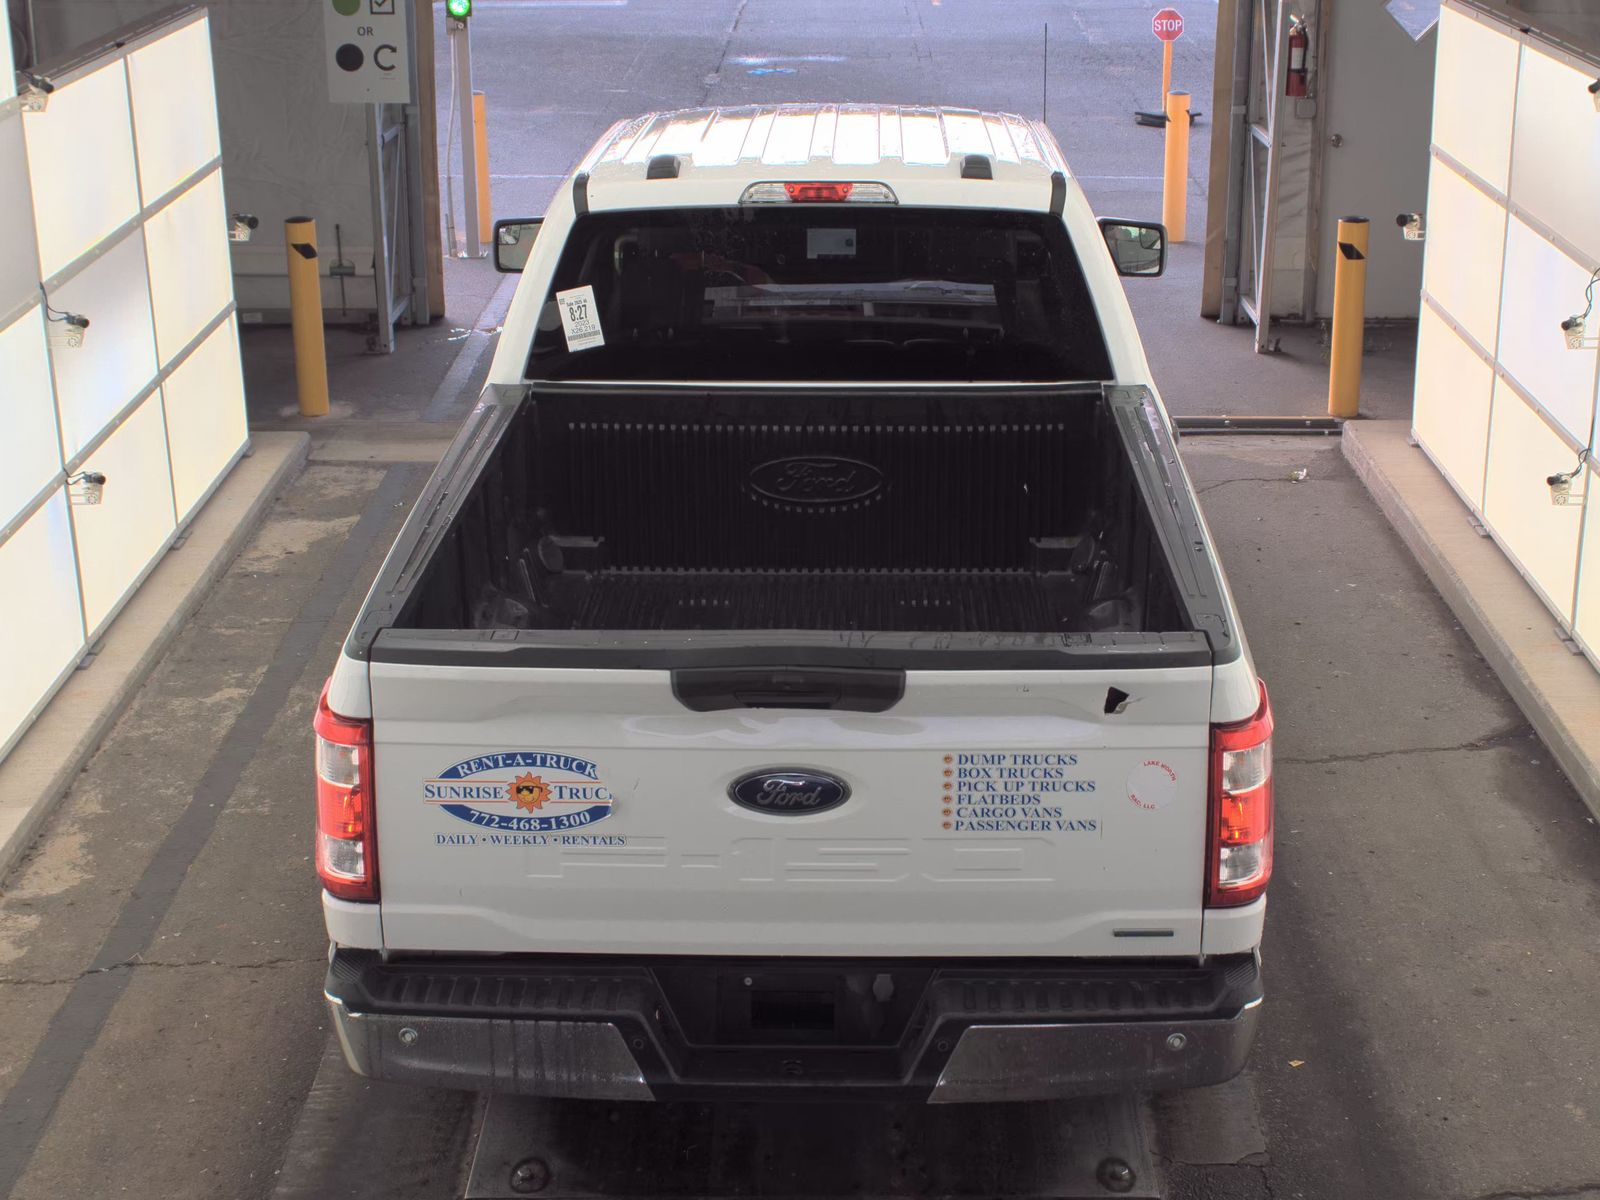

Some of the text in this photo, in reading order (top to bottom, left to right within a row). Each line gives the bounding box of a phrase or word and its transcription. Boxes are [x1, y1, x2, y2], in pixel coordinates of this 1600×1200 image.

[357, 26, 374, 36] OR
[1154, 19, 1182, 31] STOP
[569, 304, 588, 322] 8:27
[776, 462, 856, 493] Ford
[958, 754, 1078, 765] DUMP TRUCKS
[457, 753, 599, 779] RENT-A-TRUCK
[958, 768, 1064, 779] BOX TRUCKS
[424, 784, 612, 800] SUNRISE TRUC
[756, 779, 822, 805] Ford
[958, 781, 1096, 792] PICK UP TRUCKS
[957, 794, 1041, 805] FLATBEDS
[957, 807, 1062, 818] CARGO VANS
[469, 810, 590, 831] 772-468-1300
[955, 820, 1097, 831] PASSENGER VANS
[436, 834, 626, 846] DAILY WEEKLY RENTALS
